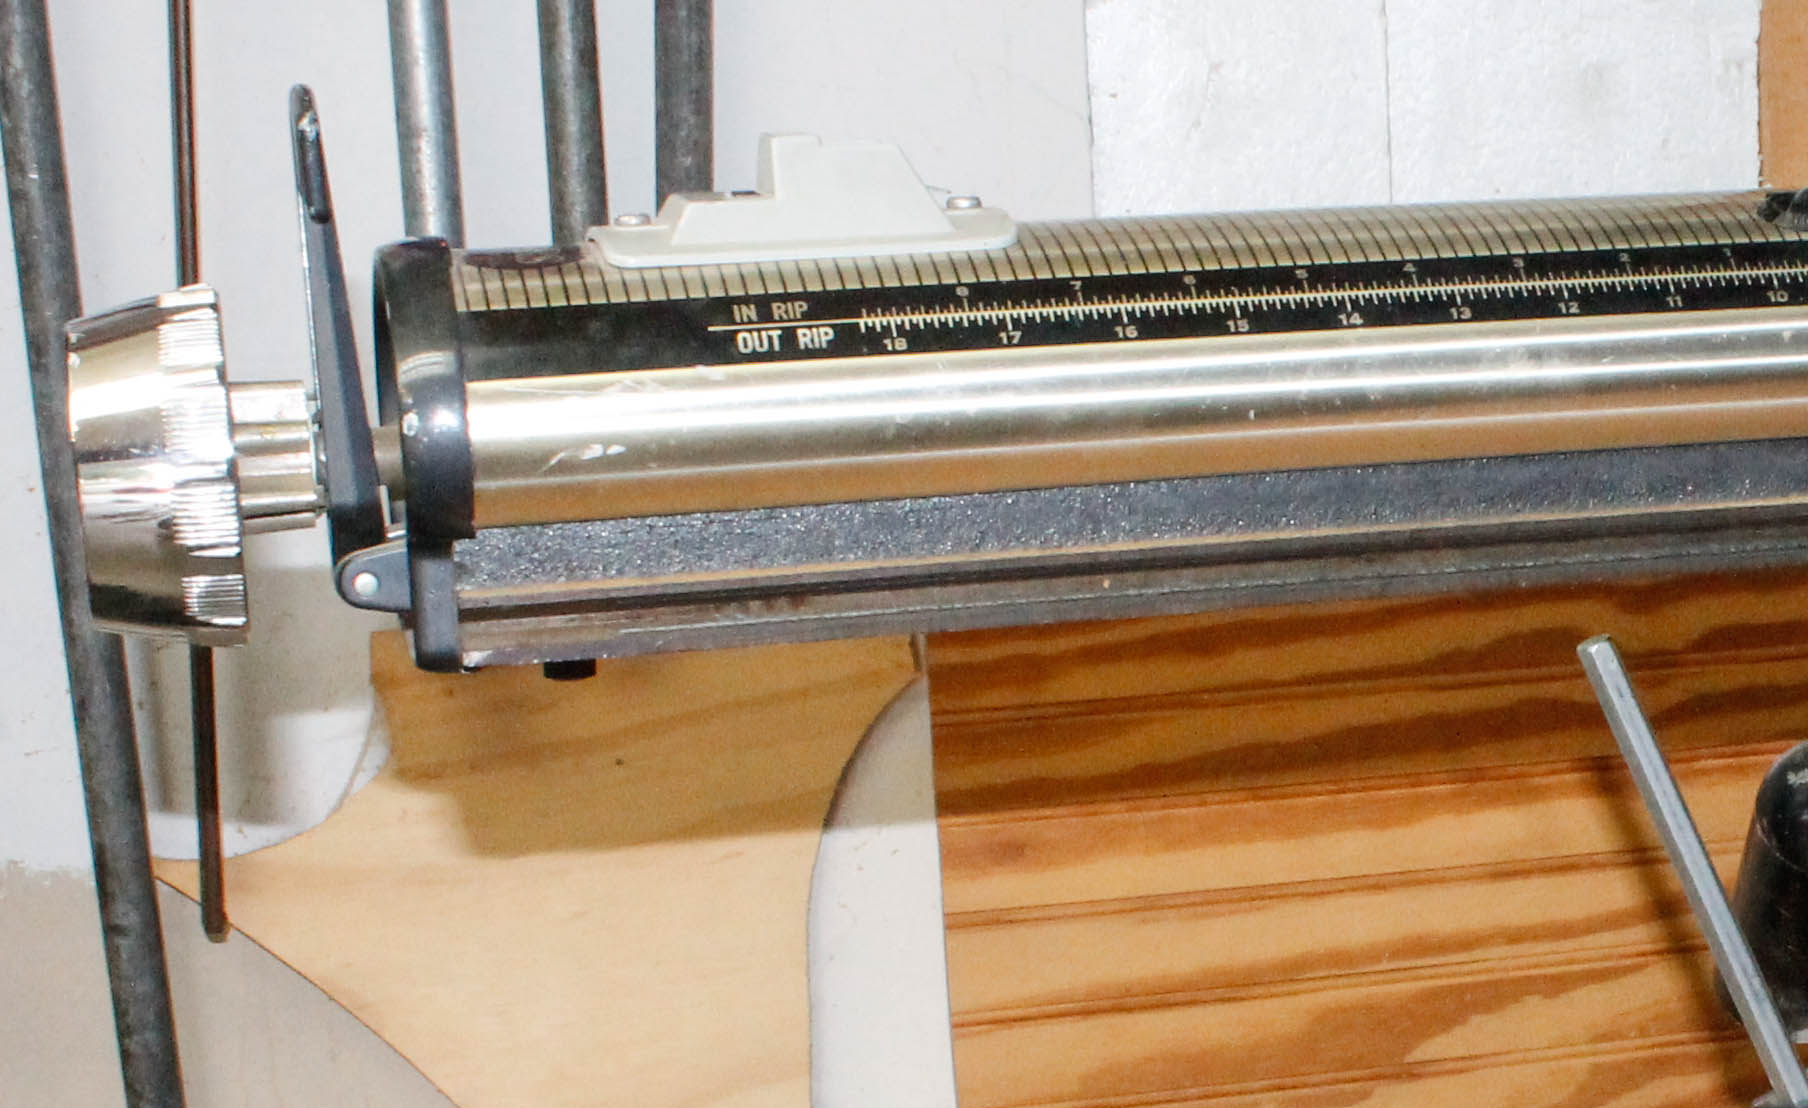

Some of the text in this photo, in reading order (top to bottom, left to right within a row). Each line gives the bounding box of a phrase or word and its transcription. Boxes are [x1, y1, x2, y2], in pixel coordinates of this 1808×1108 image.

[1069, 280, 1082, 290] 7
[1295, 268, 1309, 280] 5
[1403, 262, 1417, 272] 4
[1513, 257, 1525, 268] 3
[1618, 252, 1631, 262] 2
[732, 301, 808, 322] IN RIP
[883, 337, 908, 351] 18
[1000, 331, 1022, 345] 17
[1114, 325, 1139, 339] 16
[1226, 319, 1250, 333] 15
[1338, 312, 1364, 326] 14
[1450, 307, 1472, 320] 13
[1558, 302, 1581, 314] 12
[1666, 296, 1683, 307] 11
[1766, 291, 1789, 303] 10
[736, 327, 835, 354] OUT RIP
